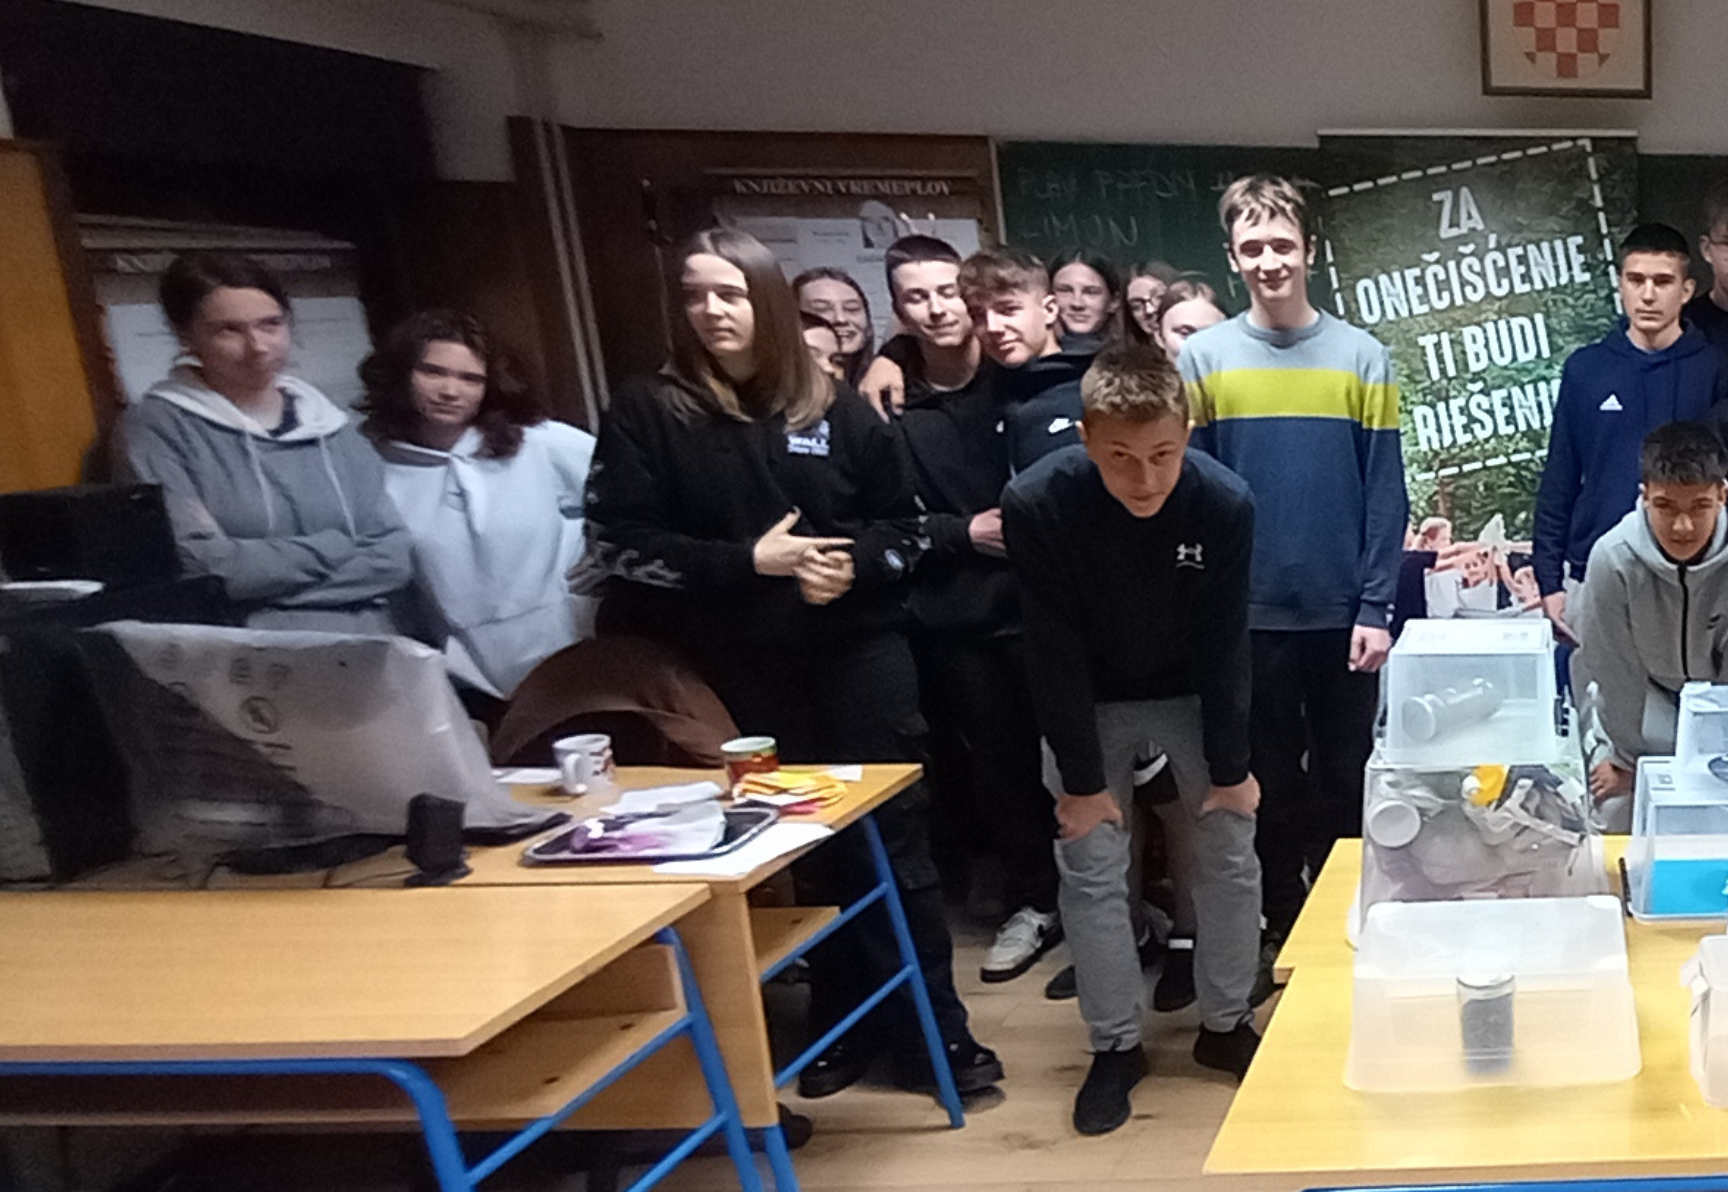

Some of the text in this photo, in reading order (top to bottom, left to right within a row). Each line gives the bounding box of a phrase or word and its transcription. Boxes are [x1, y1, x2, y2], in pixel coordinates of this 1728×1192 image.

[734, 177, 951, 197] KNJIŽEVNI VREMEPLOV
[1431, 186, 1486, 240] ZA
[1355, 233, 1592, 325] ONEČIŠĆENJE
[1417, 312, 1551, 382] TI BUDI
